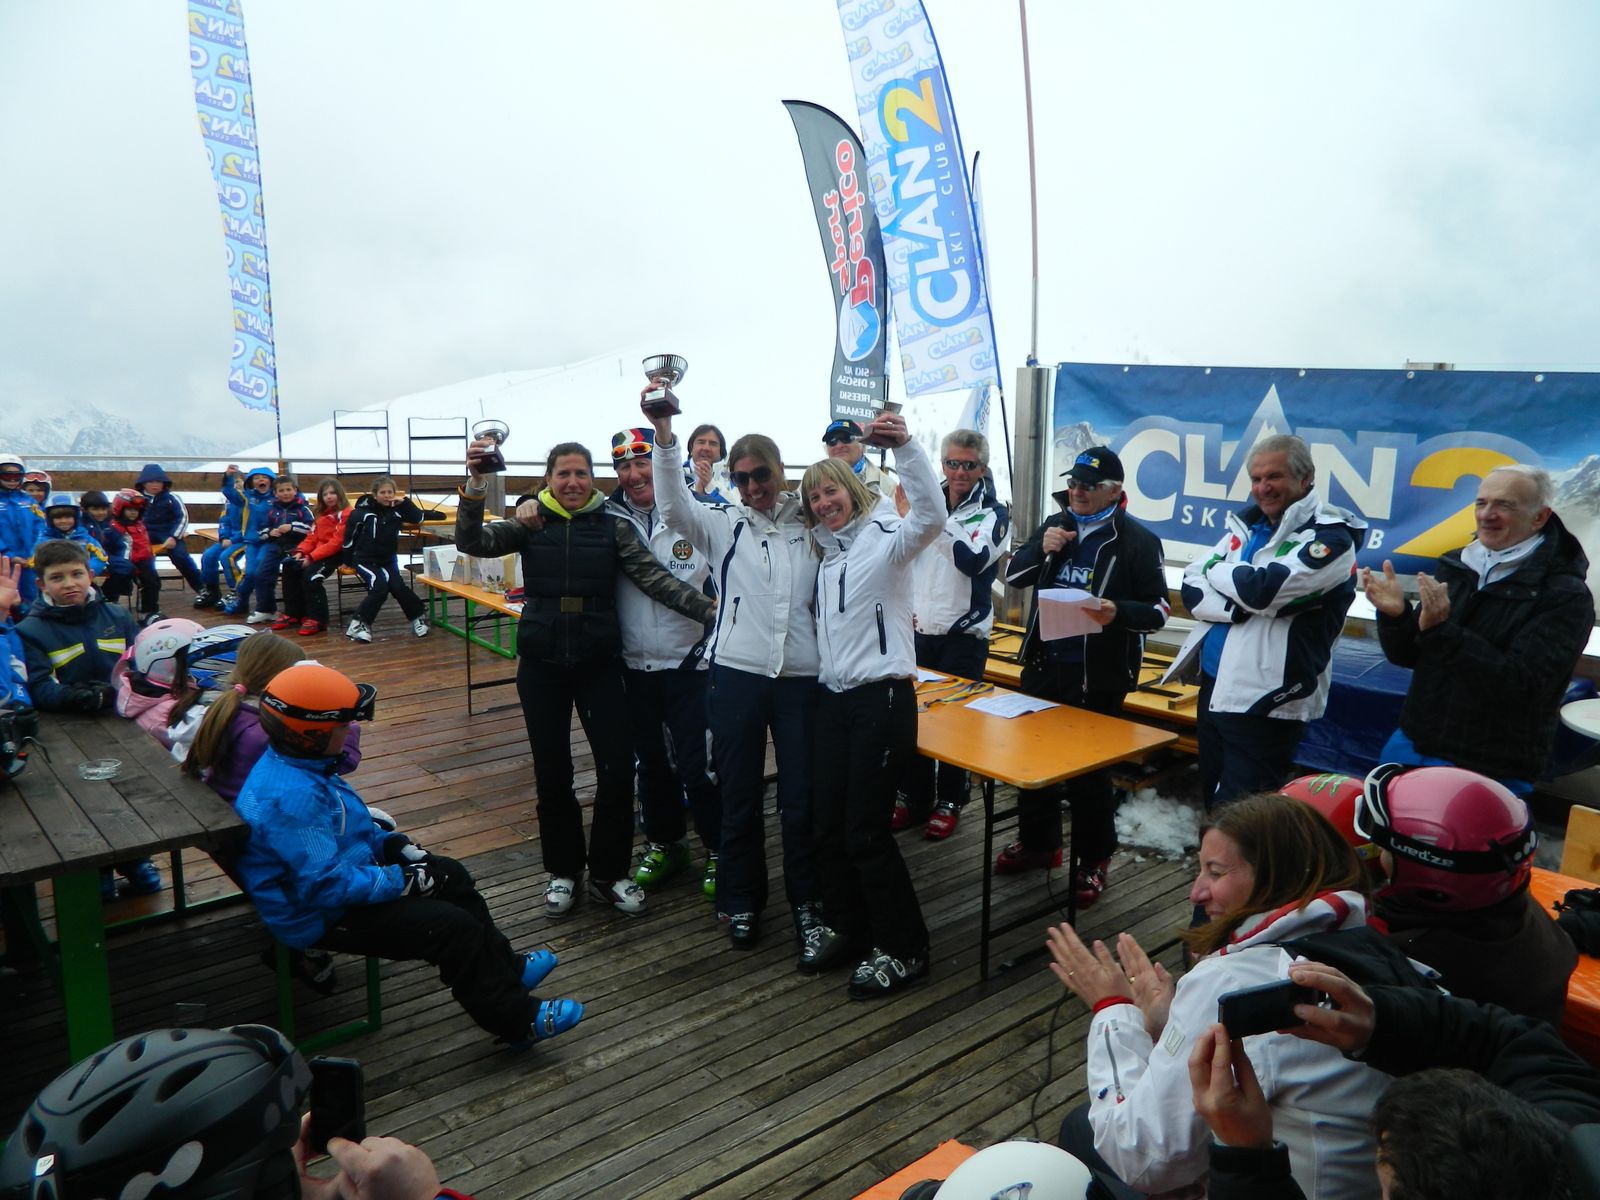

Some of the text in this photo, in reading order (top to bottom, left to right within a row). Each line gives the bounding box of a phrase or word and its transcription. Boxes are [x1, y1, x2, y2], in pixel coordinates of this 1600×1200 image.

[935, 142, 953, 195] CLUB
[883, 77, 971, 320] CLAN2
[949, 231, 966, 265] SKI
[670, 561, 696, 570] Bruno
